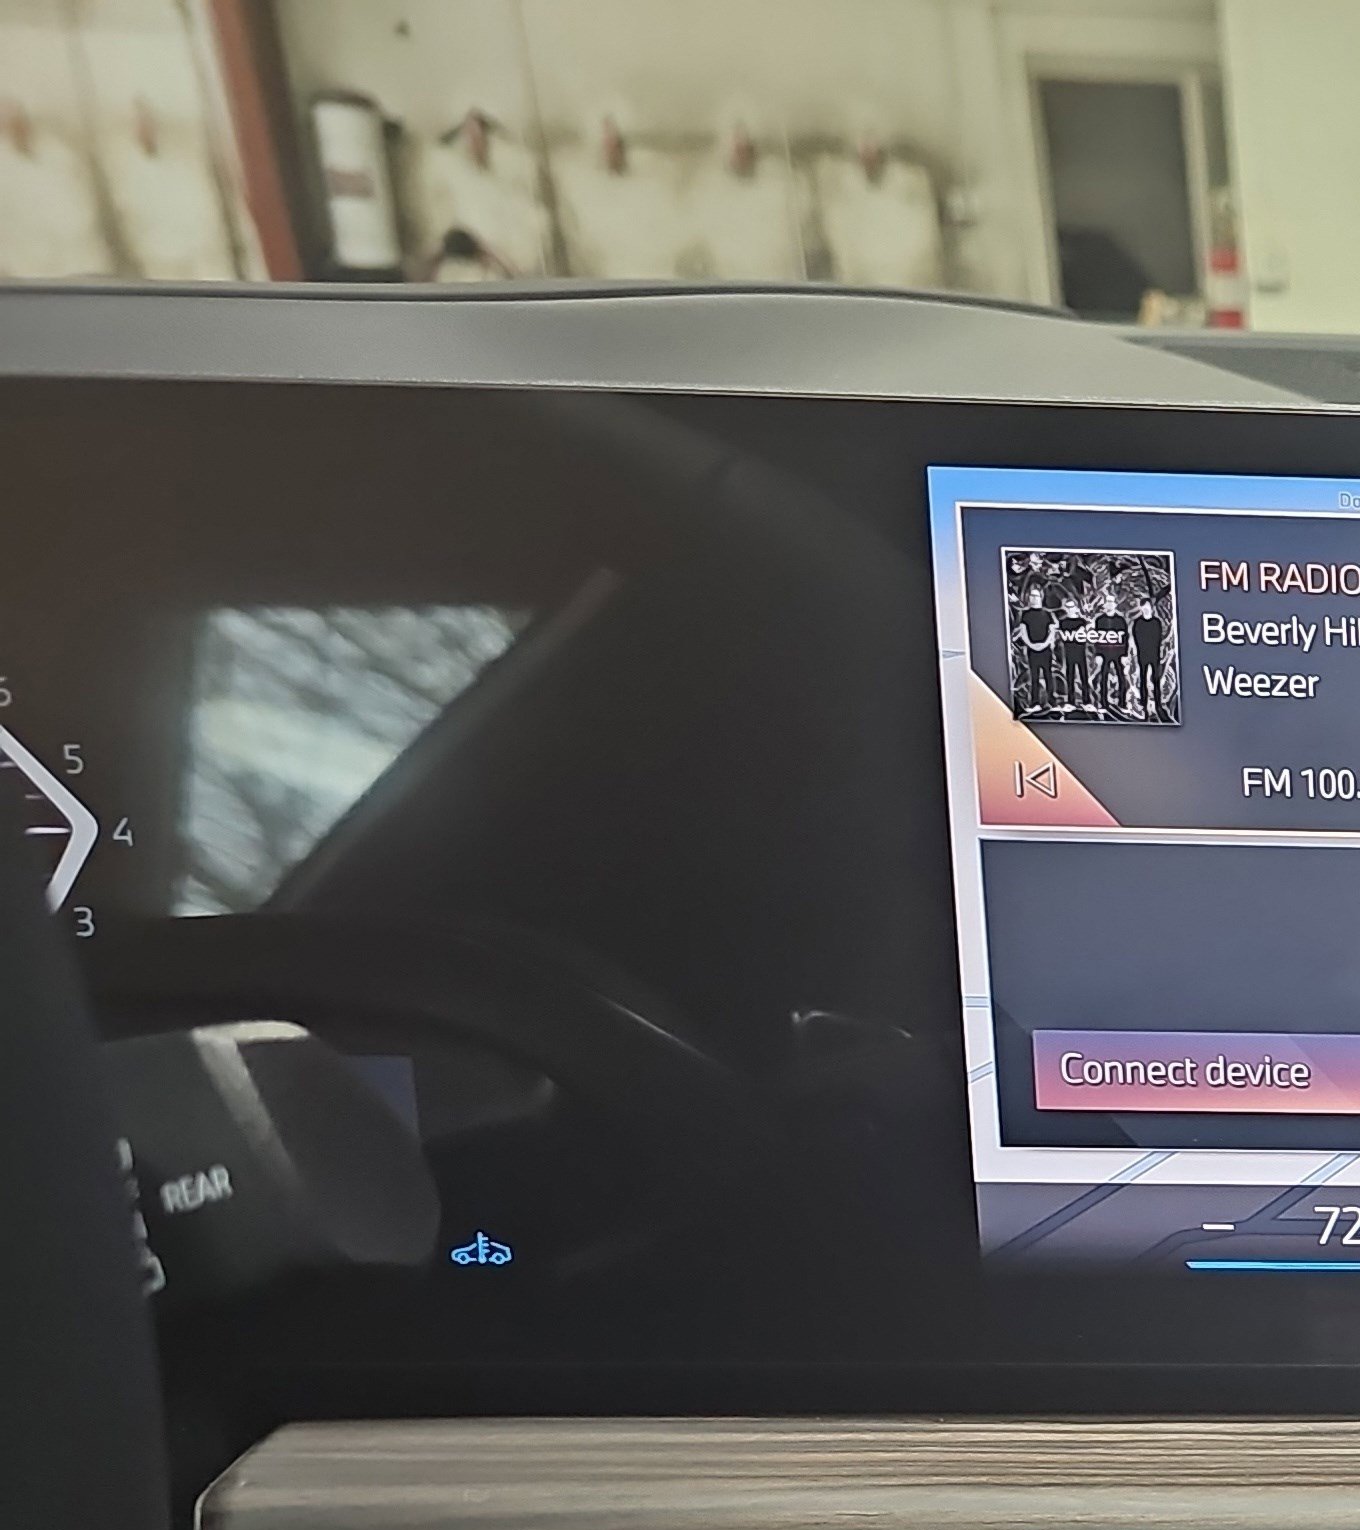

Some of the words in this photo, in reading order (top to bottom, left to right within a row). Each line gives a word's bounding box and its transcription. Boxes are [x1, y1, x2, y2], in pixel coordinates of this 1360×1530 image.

[1200, 560, 1249, 592] FM
[1059, 628, 1126, 646] weezer
[1202, 613, 1317, 652] Beverly
[1203, 665, 1320, 698] Weezer
[63, 744, 84, 775] 5
[1242, 767, 1291, 797] FM
[113, 817, 134, 847] 4
[73, 906, 95, 937] 3
[1060, 1052, 1197, 1087] Connect
[1206, 1056, 1311, 1088] device
[160, 1164, 233, 1213] REAR
